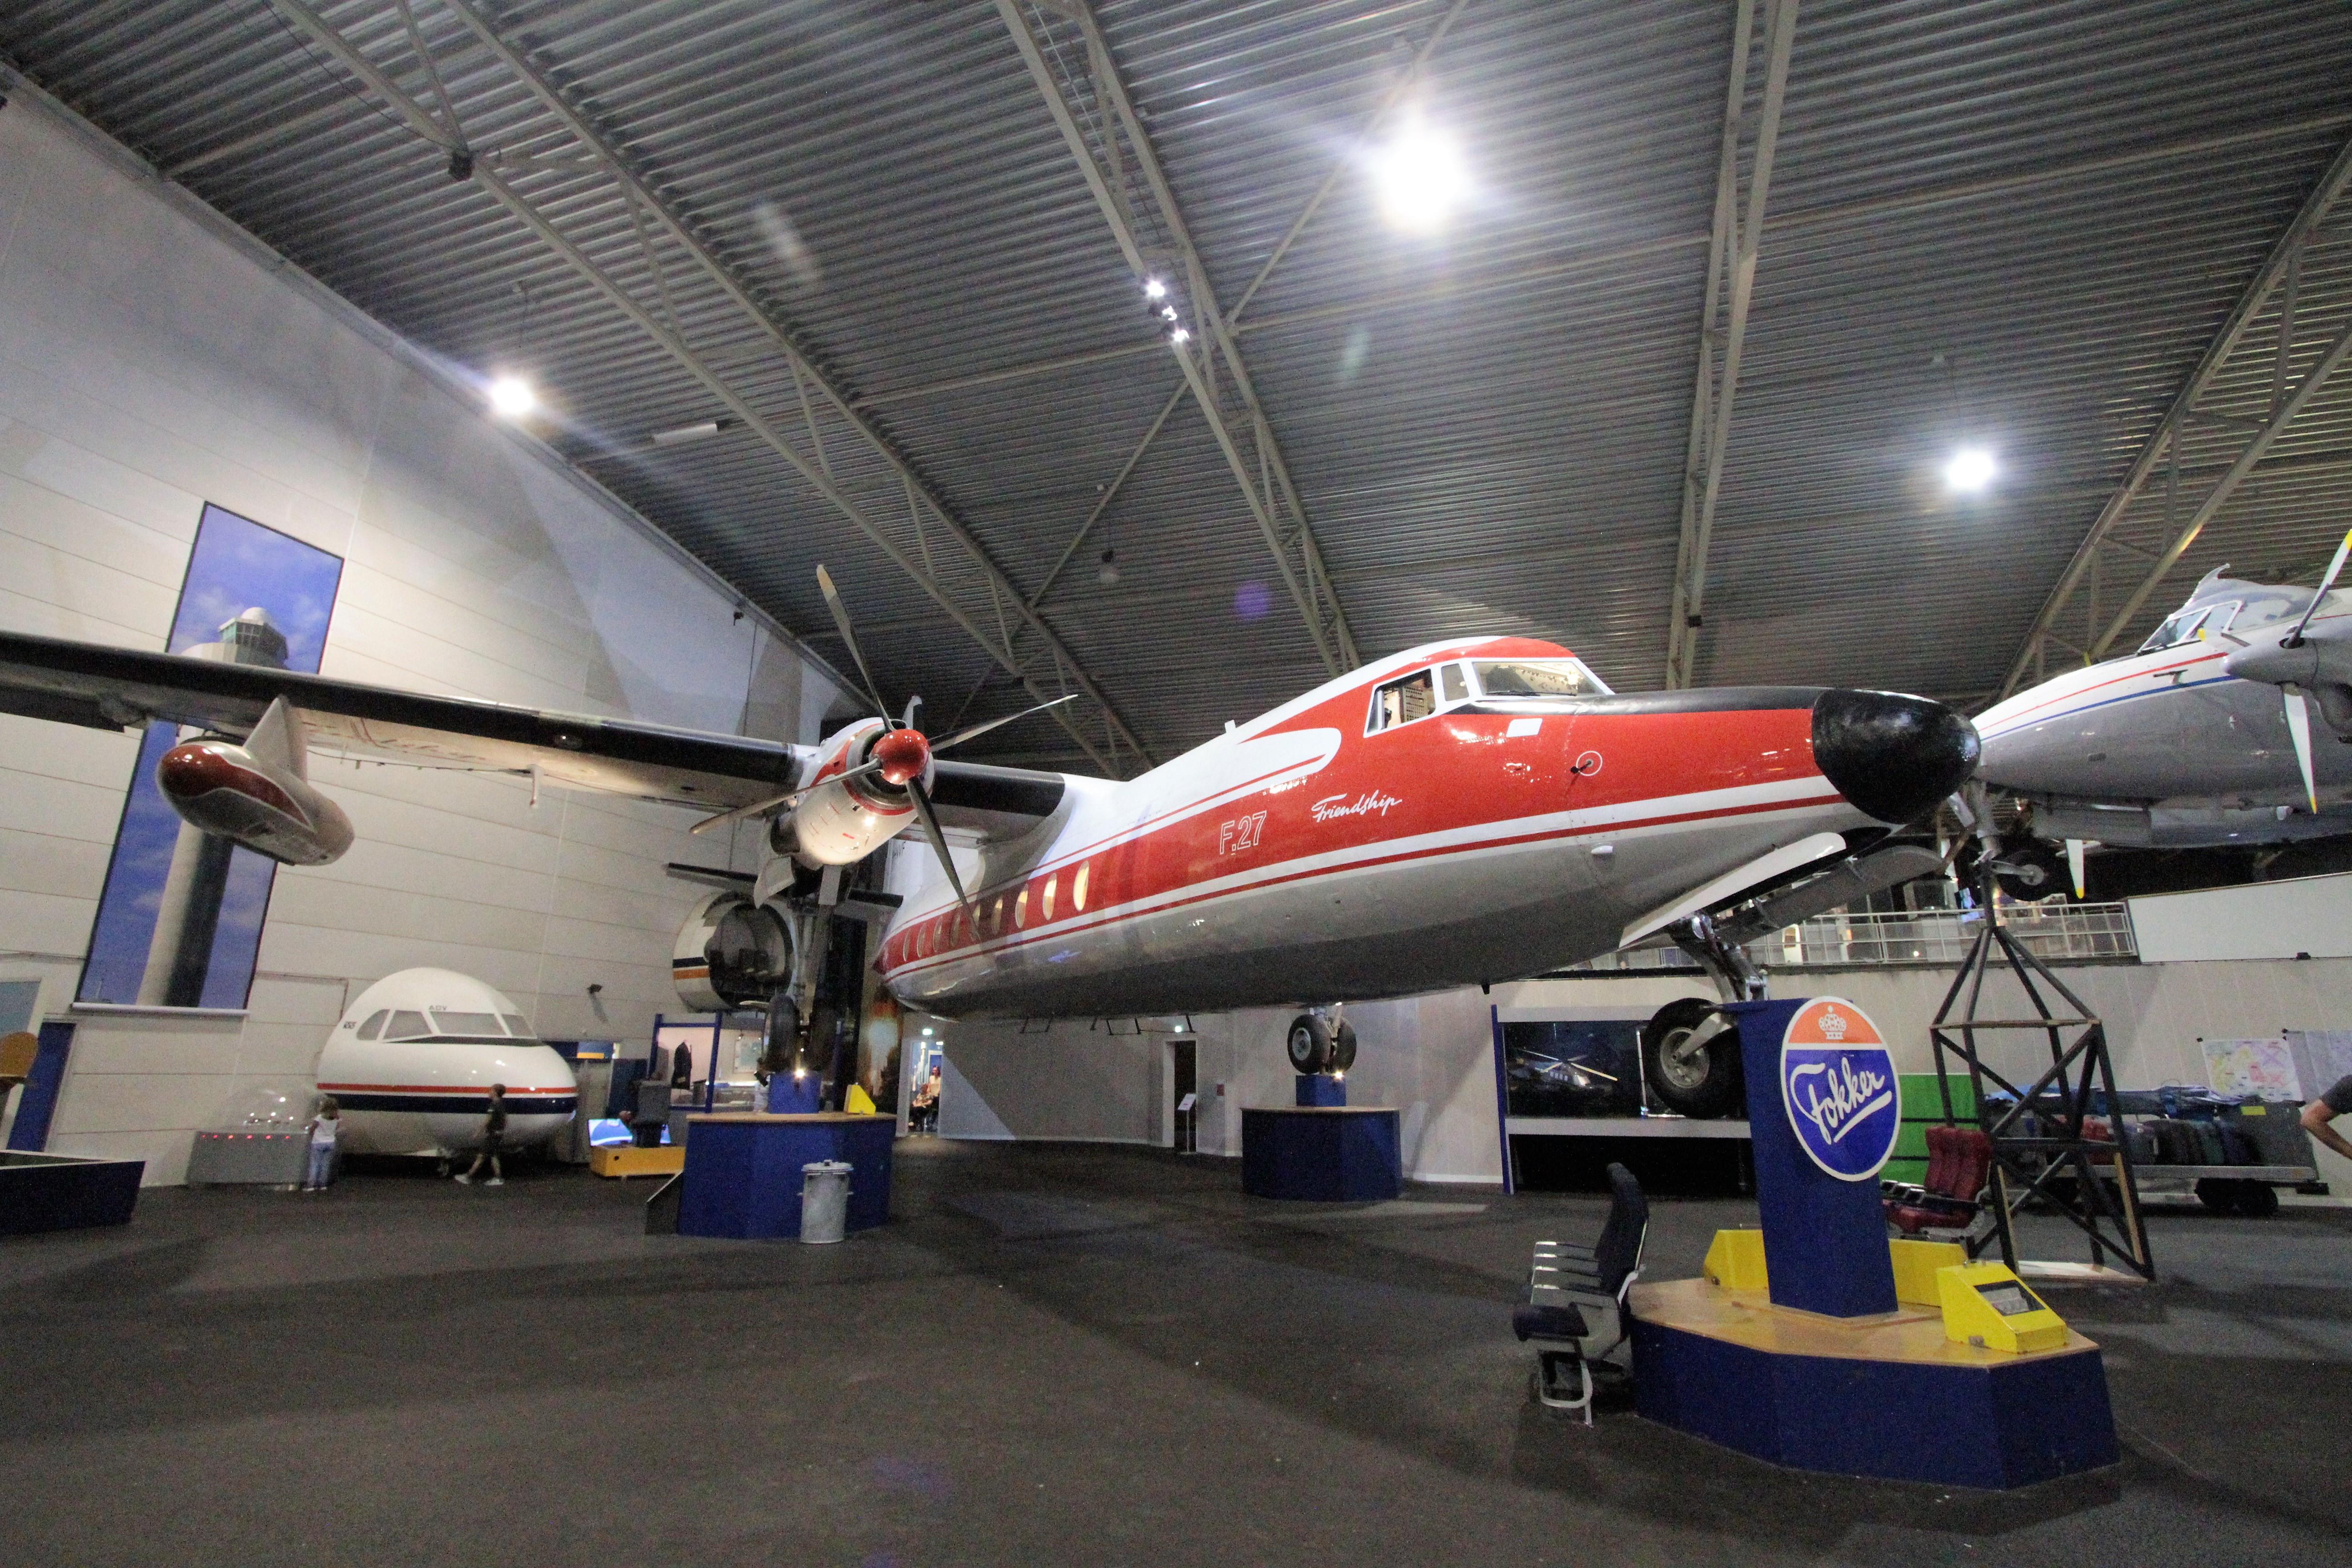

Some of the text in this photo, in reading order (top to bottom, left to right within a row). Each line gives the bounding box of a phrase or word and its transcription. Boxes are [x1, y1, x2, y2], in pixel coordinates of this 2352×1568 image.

[1311, 789, 1403, 823] Friendship
[1220, 810, 1267, 855] F.27
[1790, 1057, 1886, 1145] Fokker
